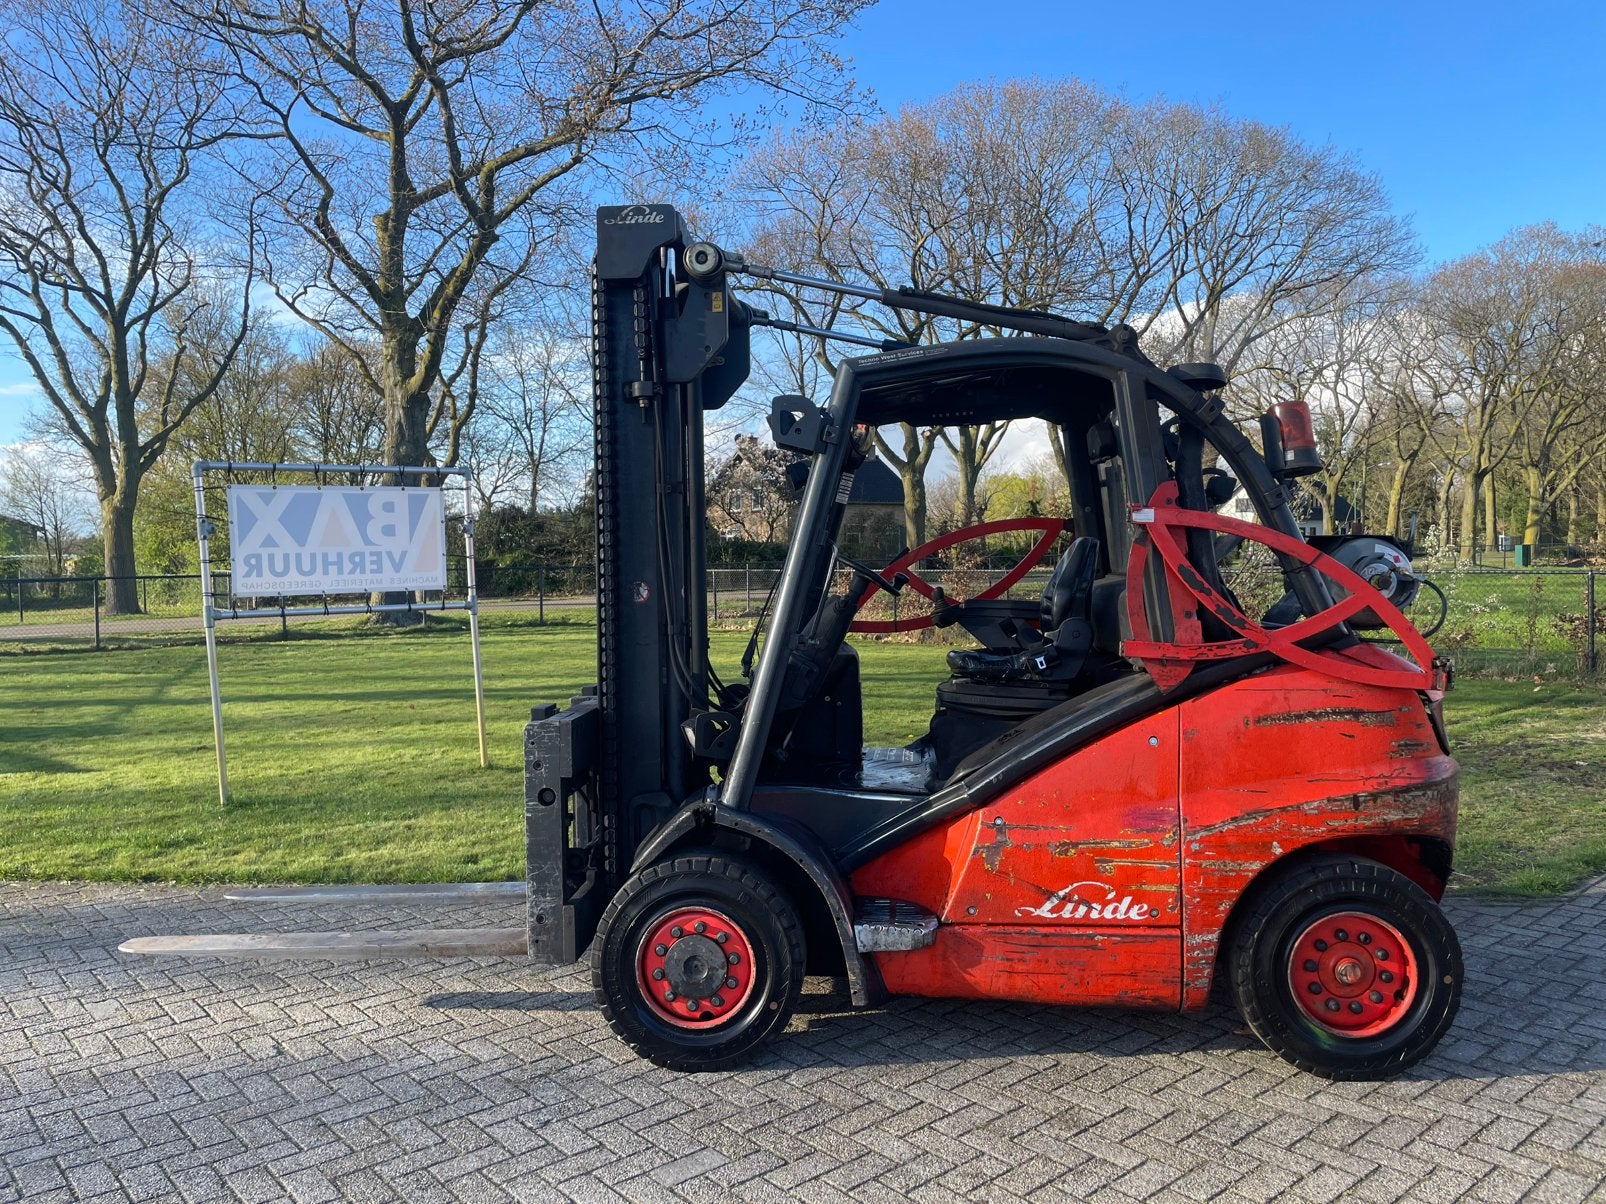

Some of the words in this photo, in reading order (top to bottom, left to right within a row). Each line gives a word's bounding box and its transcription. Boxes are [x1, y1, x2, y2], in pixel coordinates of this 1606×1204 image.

[604, 205, 664, 225] Linde
[897, 349, 924, 358] Services
[1015, 881, 1148, 920] Linde
